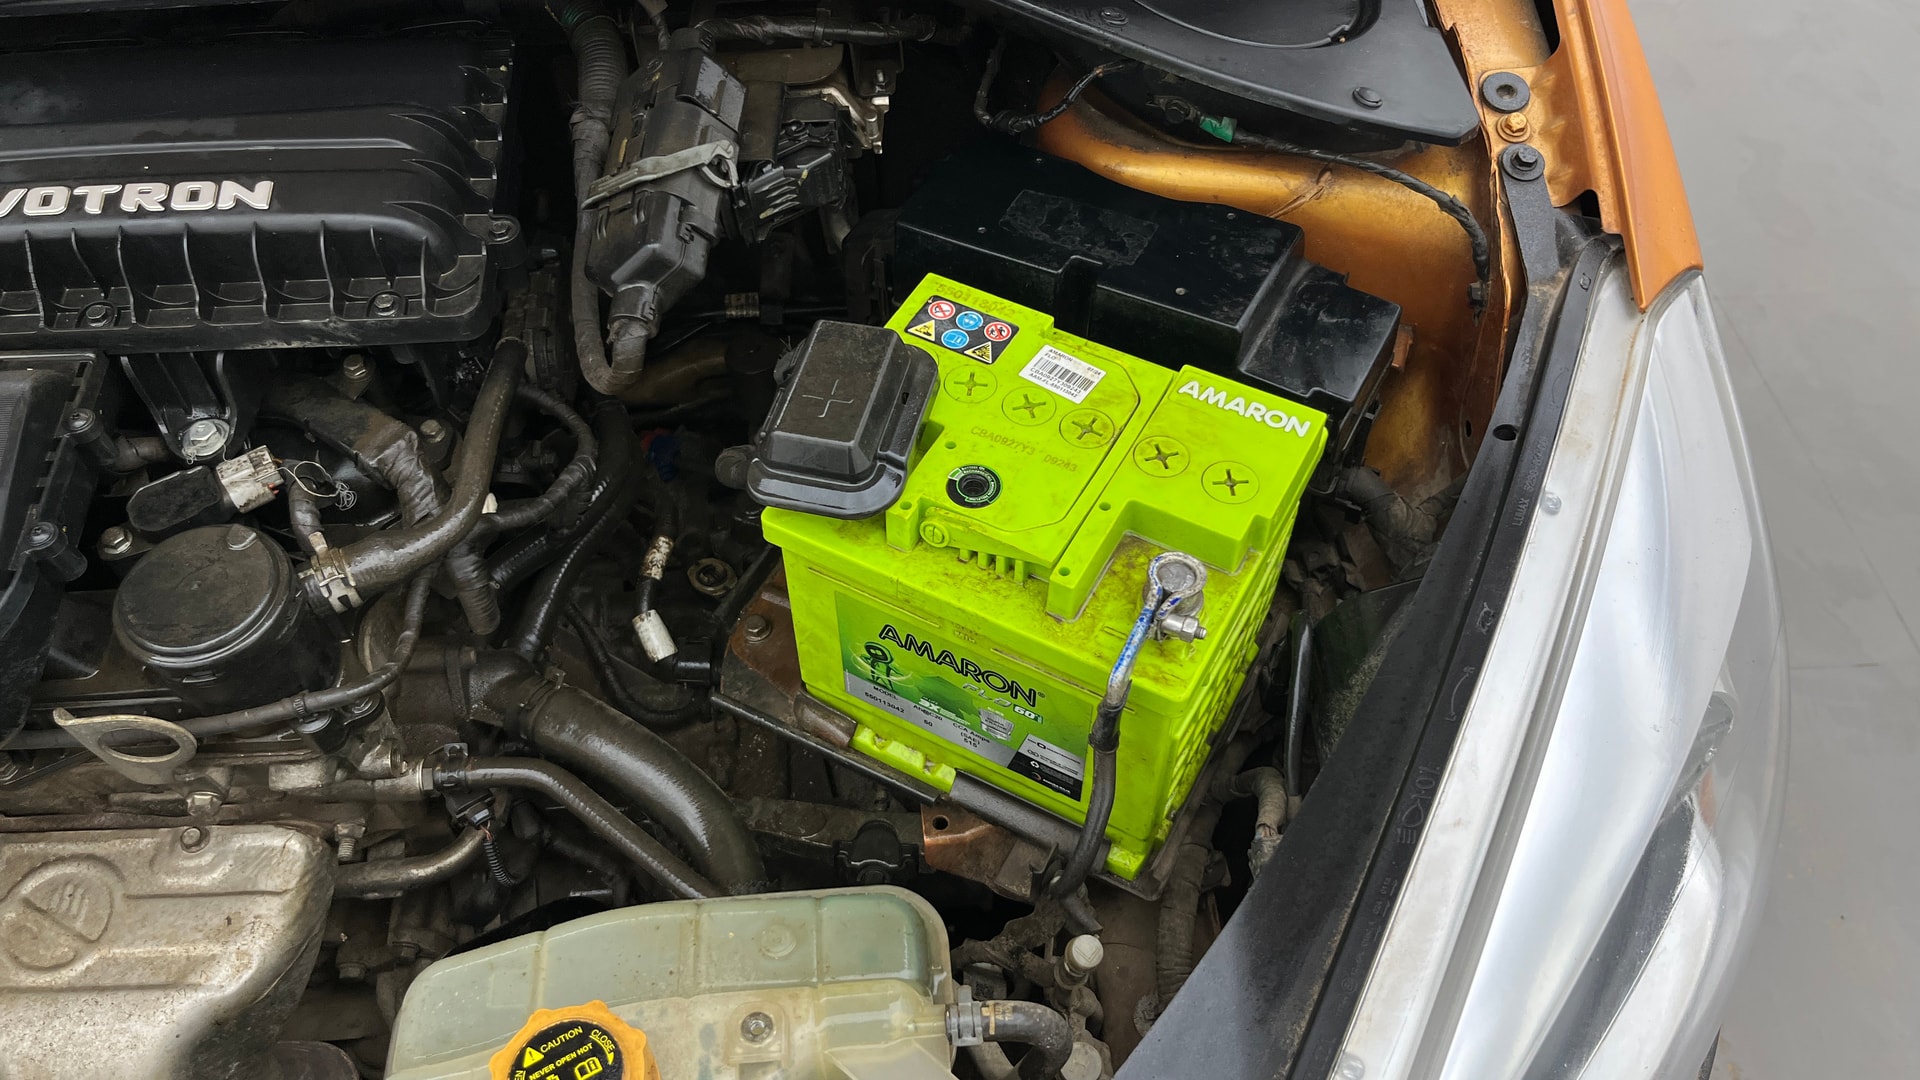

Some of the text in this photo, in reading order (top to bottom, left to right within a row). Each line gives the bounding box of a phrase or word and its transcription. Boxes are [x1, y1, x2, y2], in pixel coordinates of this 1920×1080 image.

[1048, 348, 1074, 363] AMARON
[1178, 380, 1311, 438] AMARON
[878, 623, 1037, 708] AMARON
[872, 685, 898, 701] MODEL
[962, 682, 1012, 708] FLO
[540, 1025, 584, 1054] CAUTION
[590, 1028, 616, 1055] CLOSE
[529, 1042, 594, 1080] NEVER OPEN HOT
